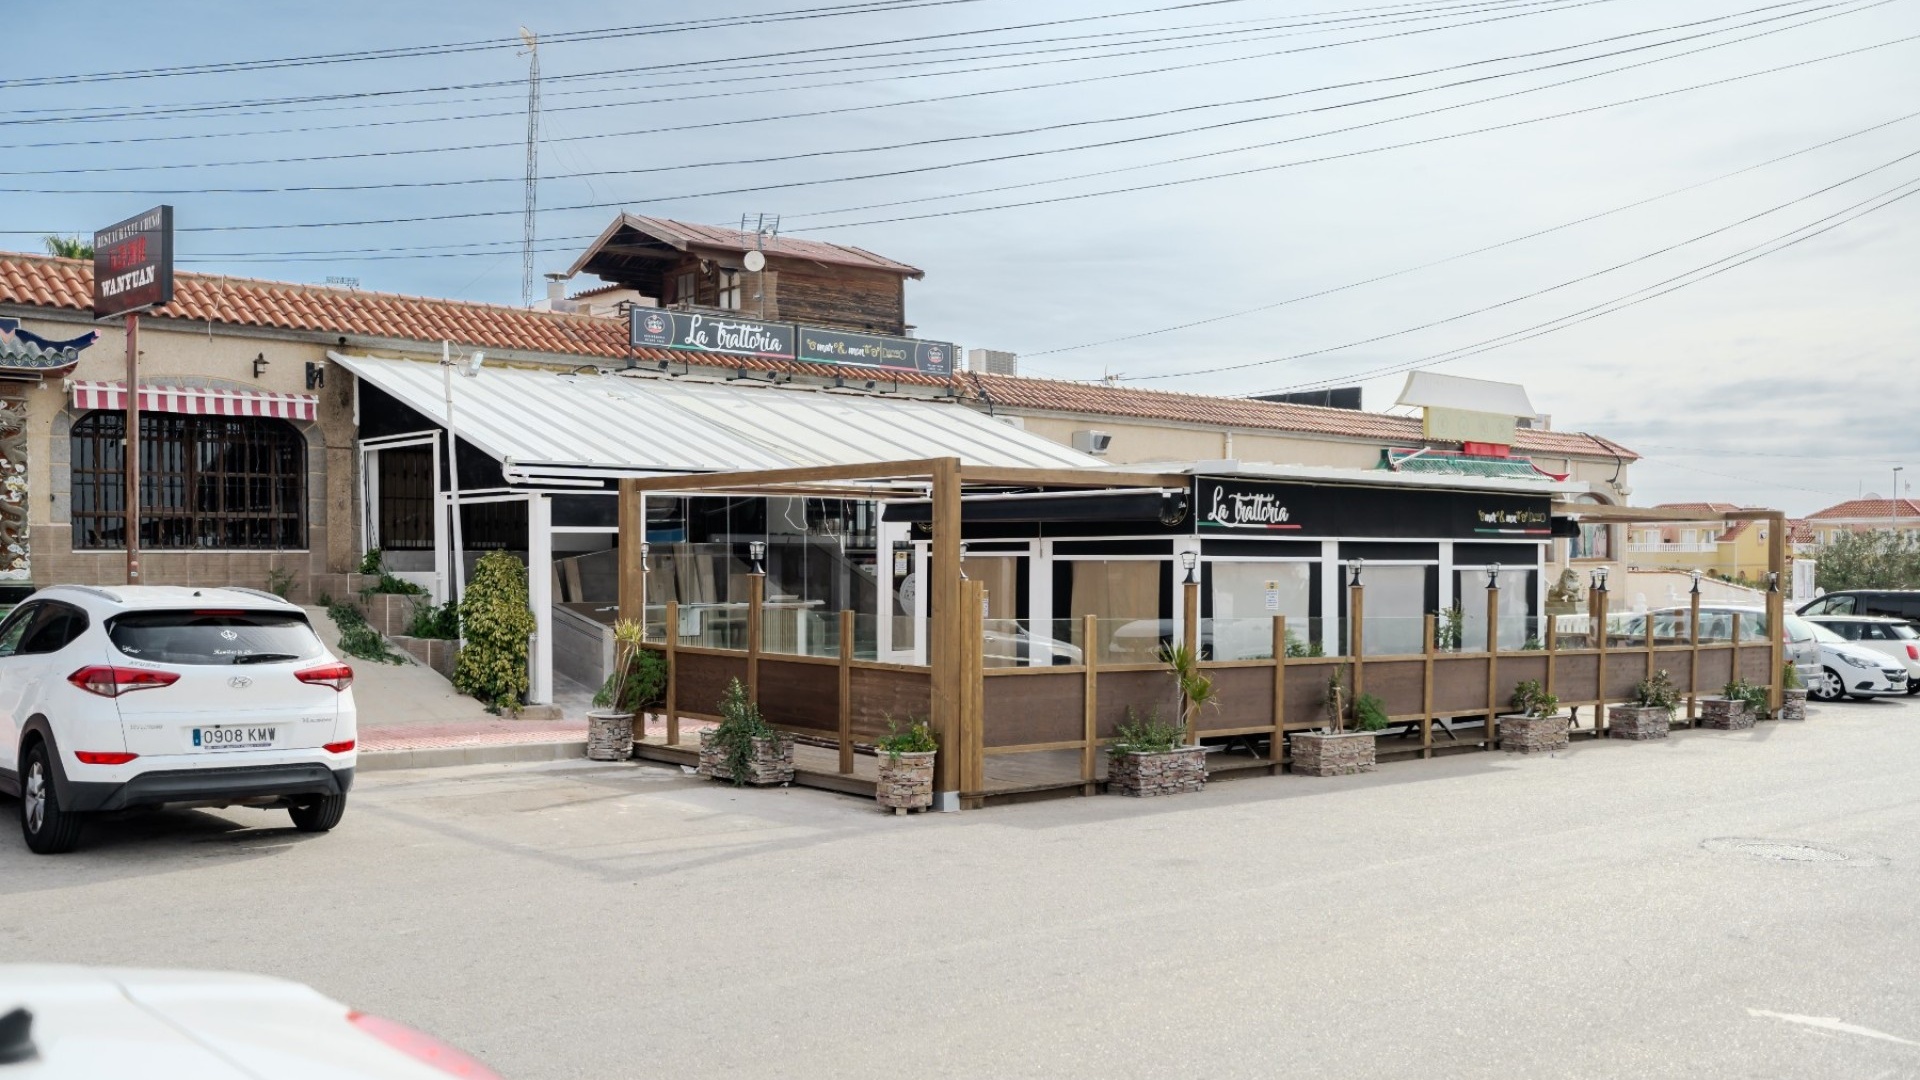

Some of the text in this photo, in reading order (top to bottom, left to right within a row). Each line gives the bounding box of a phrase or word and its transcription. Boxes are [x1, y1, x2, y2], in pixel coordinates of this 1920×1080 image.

[101, 265, 155, 298] WANYUAN
[684, 314, 709, 347] La
[1207, 485, 1229, 522] La
[204, 727, 276, 744] 0908 KMW
